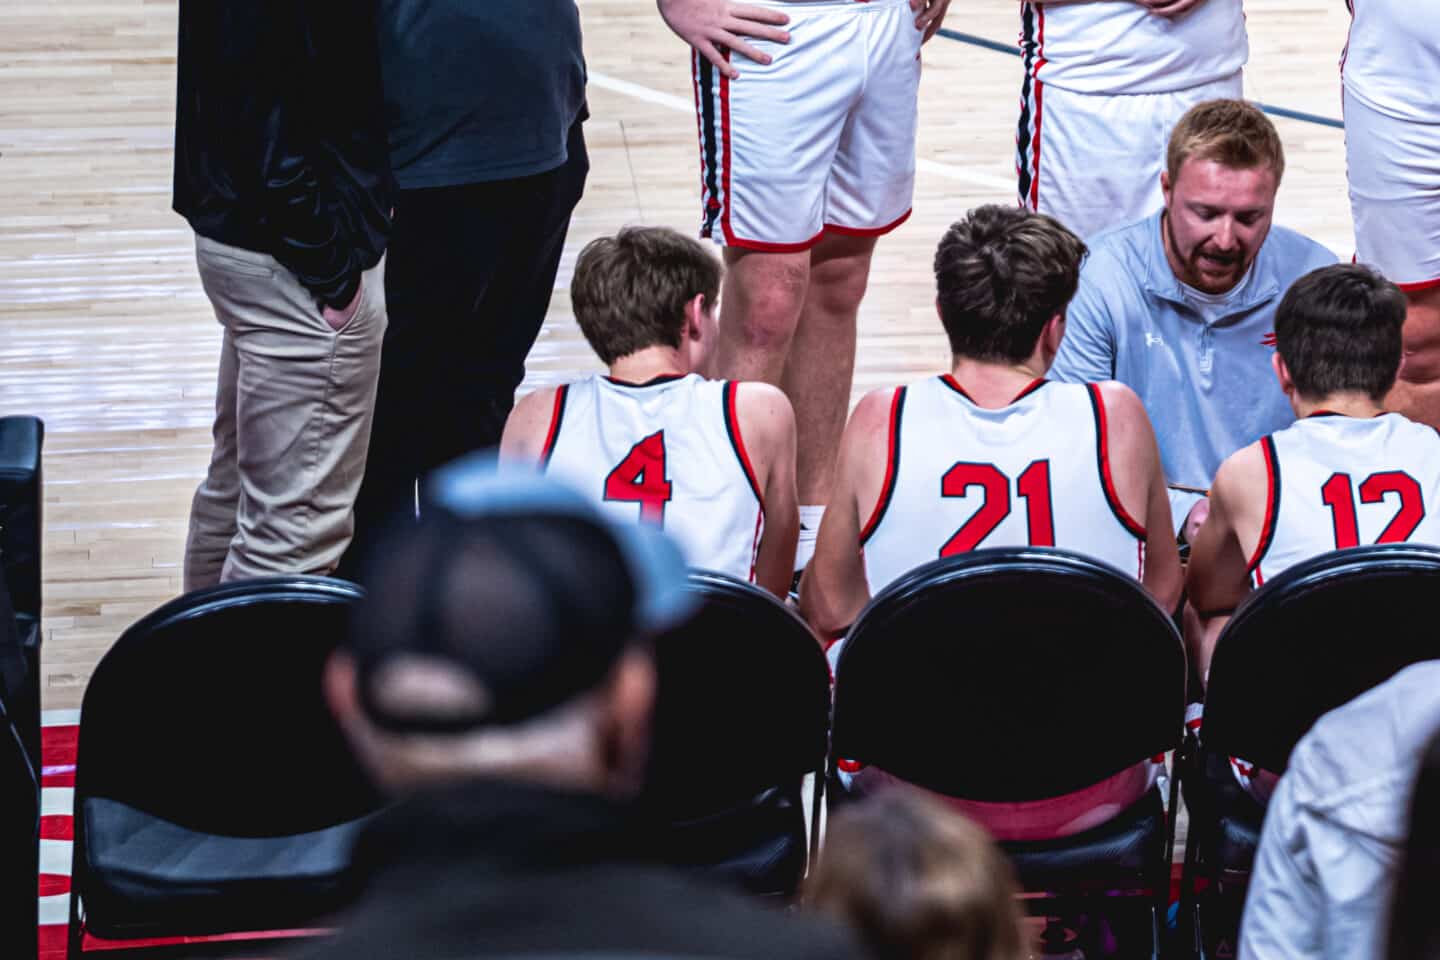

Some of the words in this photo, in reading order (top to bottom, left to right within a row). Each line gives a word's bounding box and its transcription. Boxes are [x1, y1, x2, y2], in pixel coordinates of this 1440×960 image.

[604, 430, 672, 530] 4
[939, 459, 1055, 557] 21
[1320, 470, 1426, 549] 12
